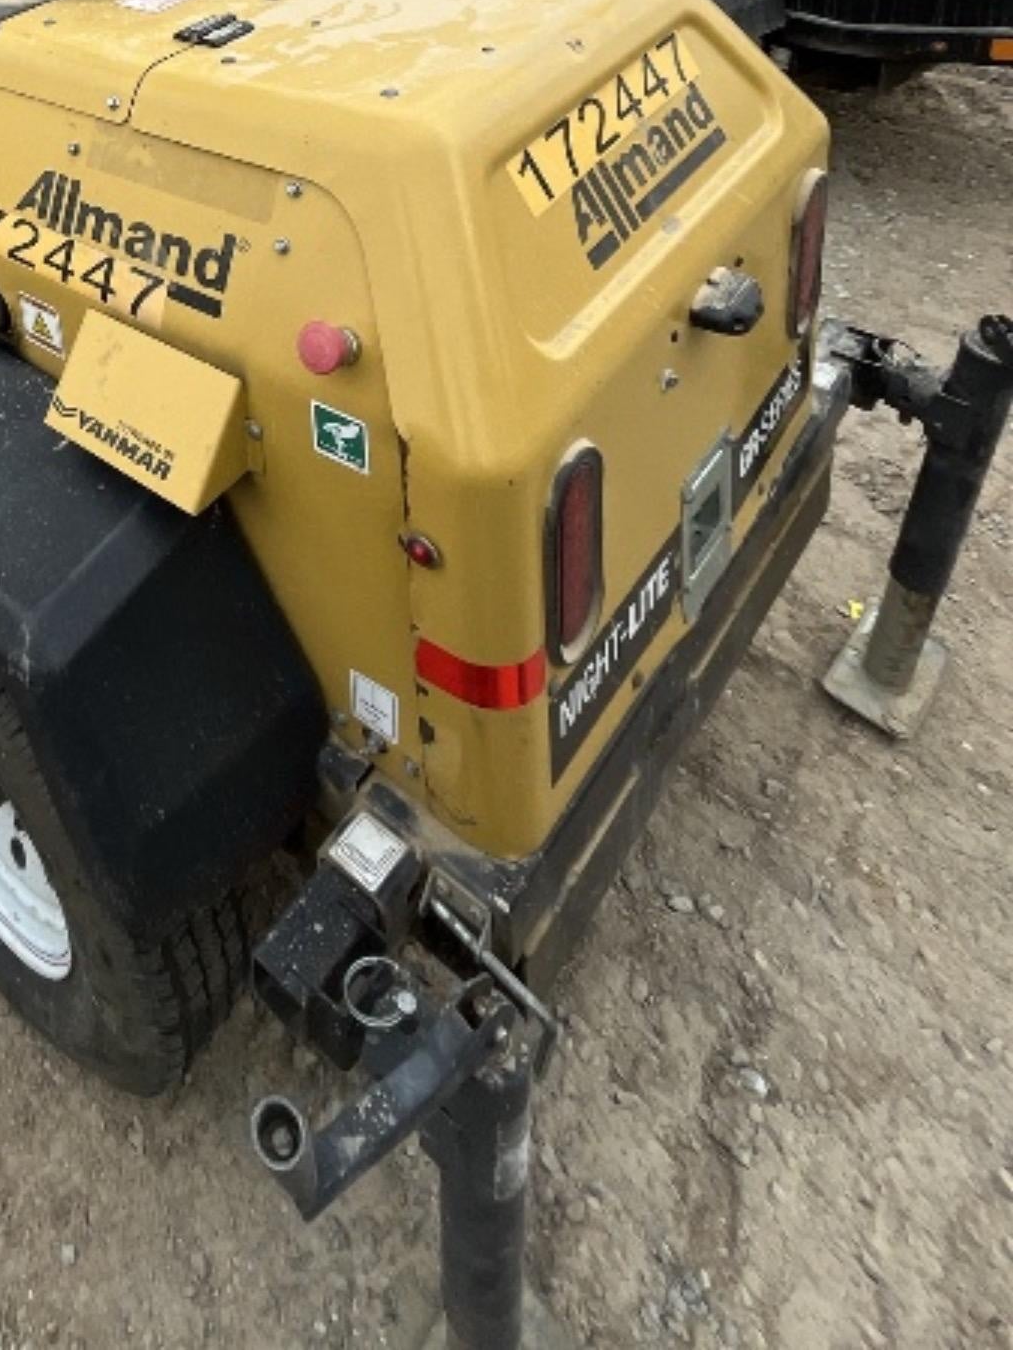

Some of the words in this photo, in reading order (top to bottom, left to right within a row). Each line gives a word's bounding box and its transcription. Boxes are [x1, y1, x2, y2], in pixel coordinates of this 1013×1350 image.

[517, 32, 687, 200] 172447
[571, 80, 716, 246] Allmand
[15, 169, 237, 293] Allmand
[559, 554, 670, 739] NIGHT-LITE
